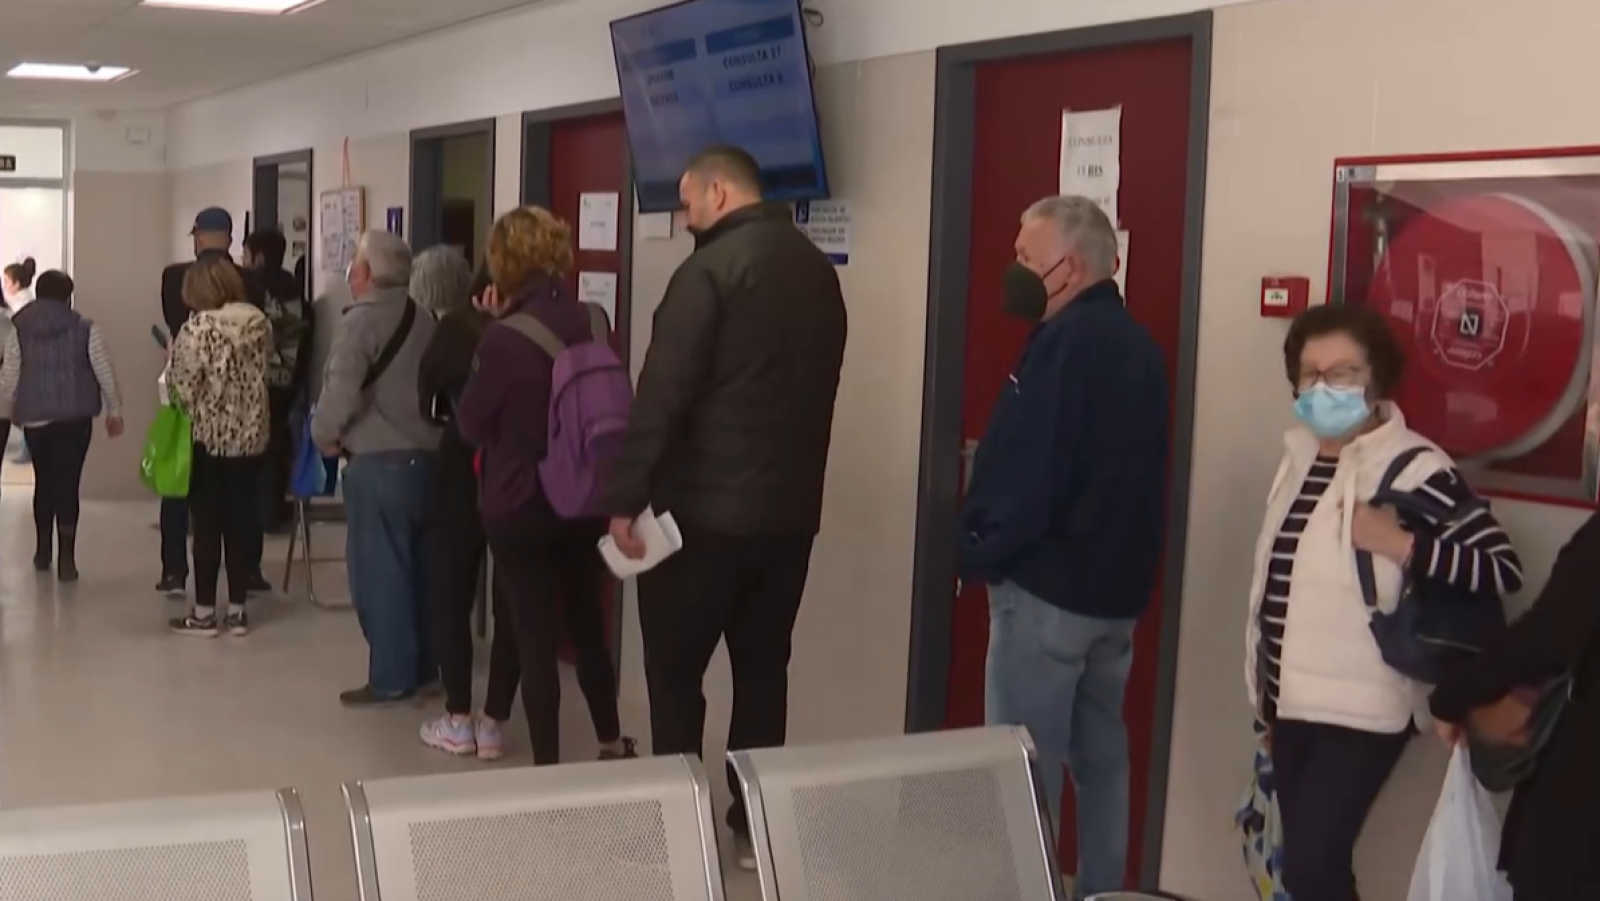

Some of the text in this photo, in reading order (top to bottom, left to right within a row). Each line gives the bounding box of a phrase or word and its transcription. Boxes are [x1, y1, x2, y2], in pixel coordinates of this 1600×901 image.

[723, 49, 769, 68] CONSULTA
[729, 74, 775, 91] CONSULTA
[1068, 134, 1113, 148] CONSULTA
